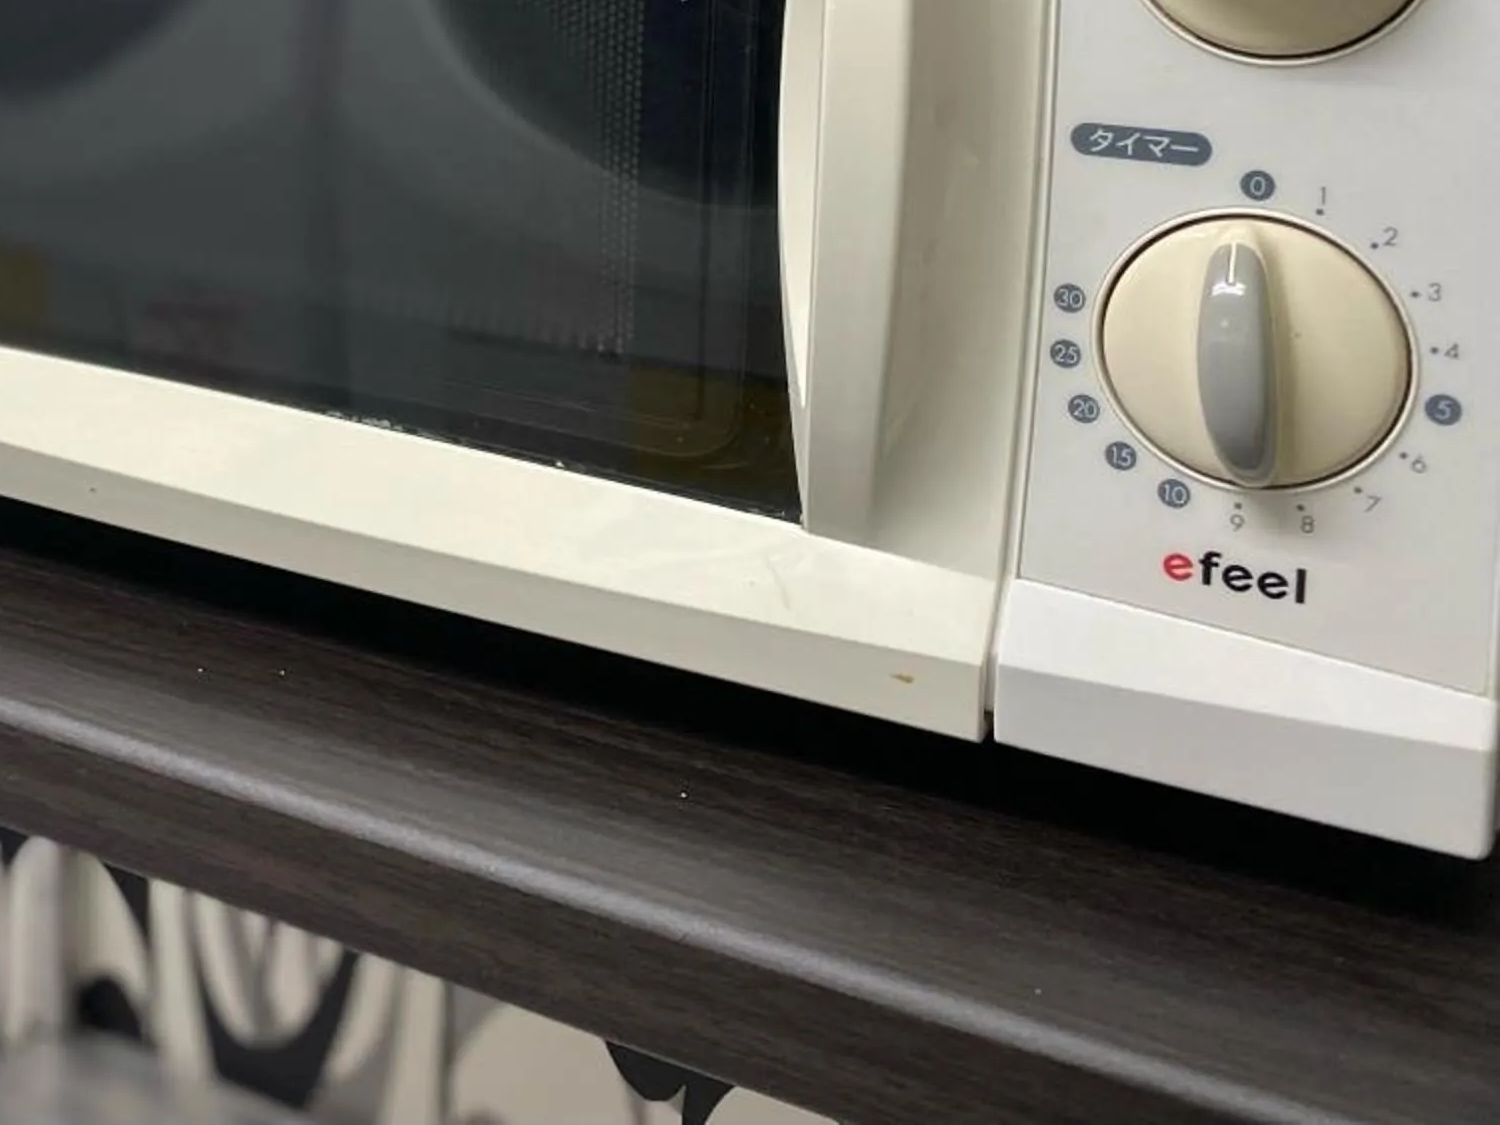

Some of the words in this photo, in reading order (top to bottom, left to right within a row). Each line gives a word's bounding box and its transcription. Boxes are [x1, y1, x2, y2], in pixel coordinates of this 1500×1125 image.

[1089, 129, 1199, 157] タイマー
[1250, 177, 1266, 196] 0
[1384, 227, 1399, 246] 2
[1057, 289, 1083, 307] 30
[1428, 283, 1443, 301] 3
[1054, 345, 1080, 363] 25
[1445, 343, 1460, 360] 4
[1071, 400, 1097, 418] 20
[1437, 402, 1453, 420] 5
[1108, 448, 1133, 465] 15
[1162, 485, 1188, 504] 10
[1365, 495, 1381, 512] 7
[1231, 515, 1245, 532] 9
[1301, 516, 1316, 534] 8
